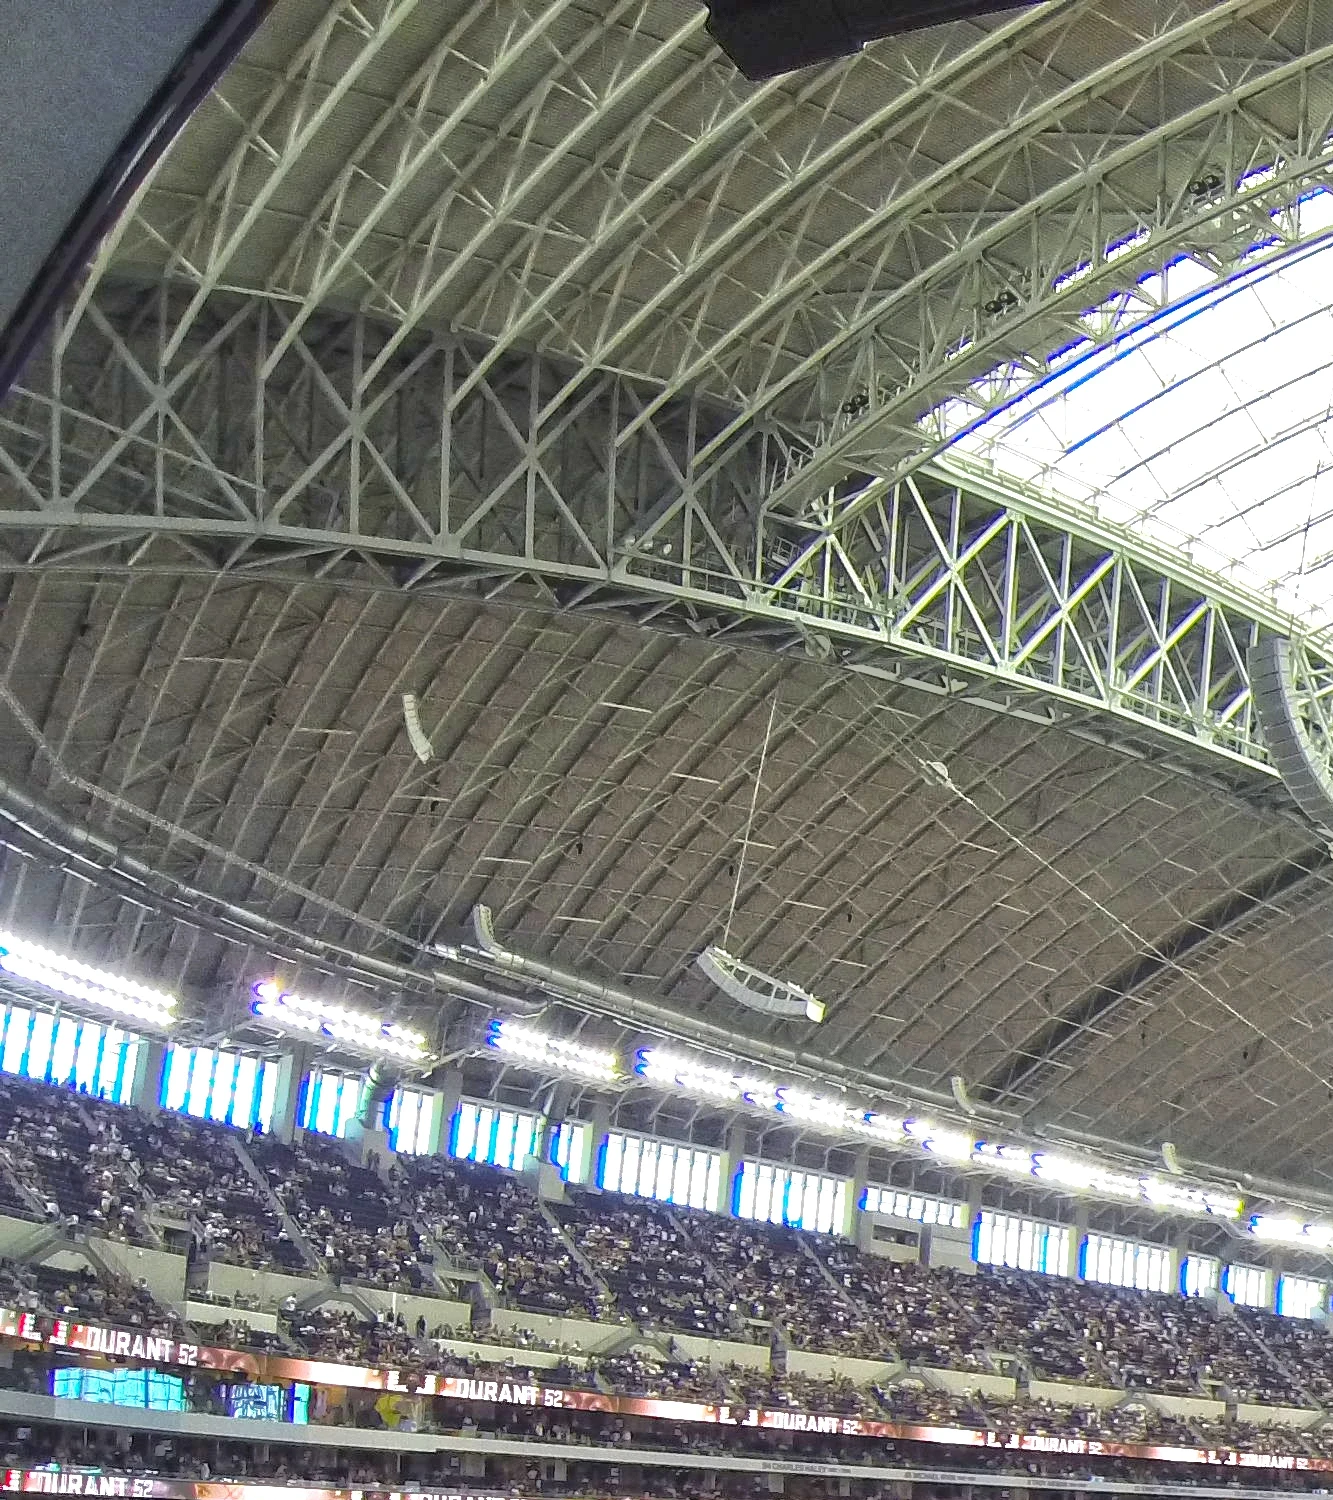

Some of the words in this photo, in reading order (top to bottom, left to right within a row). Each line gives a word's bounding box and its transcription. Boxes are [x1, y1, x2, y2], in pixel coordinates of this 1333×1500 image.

[86, 1326, 174, 1362] DURANT
[178, 1343, 198, 1367] 52
[456, 1378, 540, 1406] DURANT
[544, 1389, 563, 1408] 52
[774, 1412, 840, 1434] DURANT
[842, 1420, 859, 1435] 52
[1031, 1436, 1087, 1454] DURANT
[1250, 1453, 1295, 1469] DURANT
[36, 1471, 128, 1497] DURANT
[133, 1480, 154, 1498] 52
